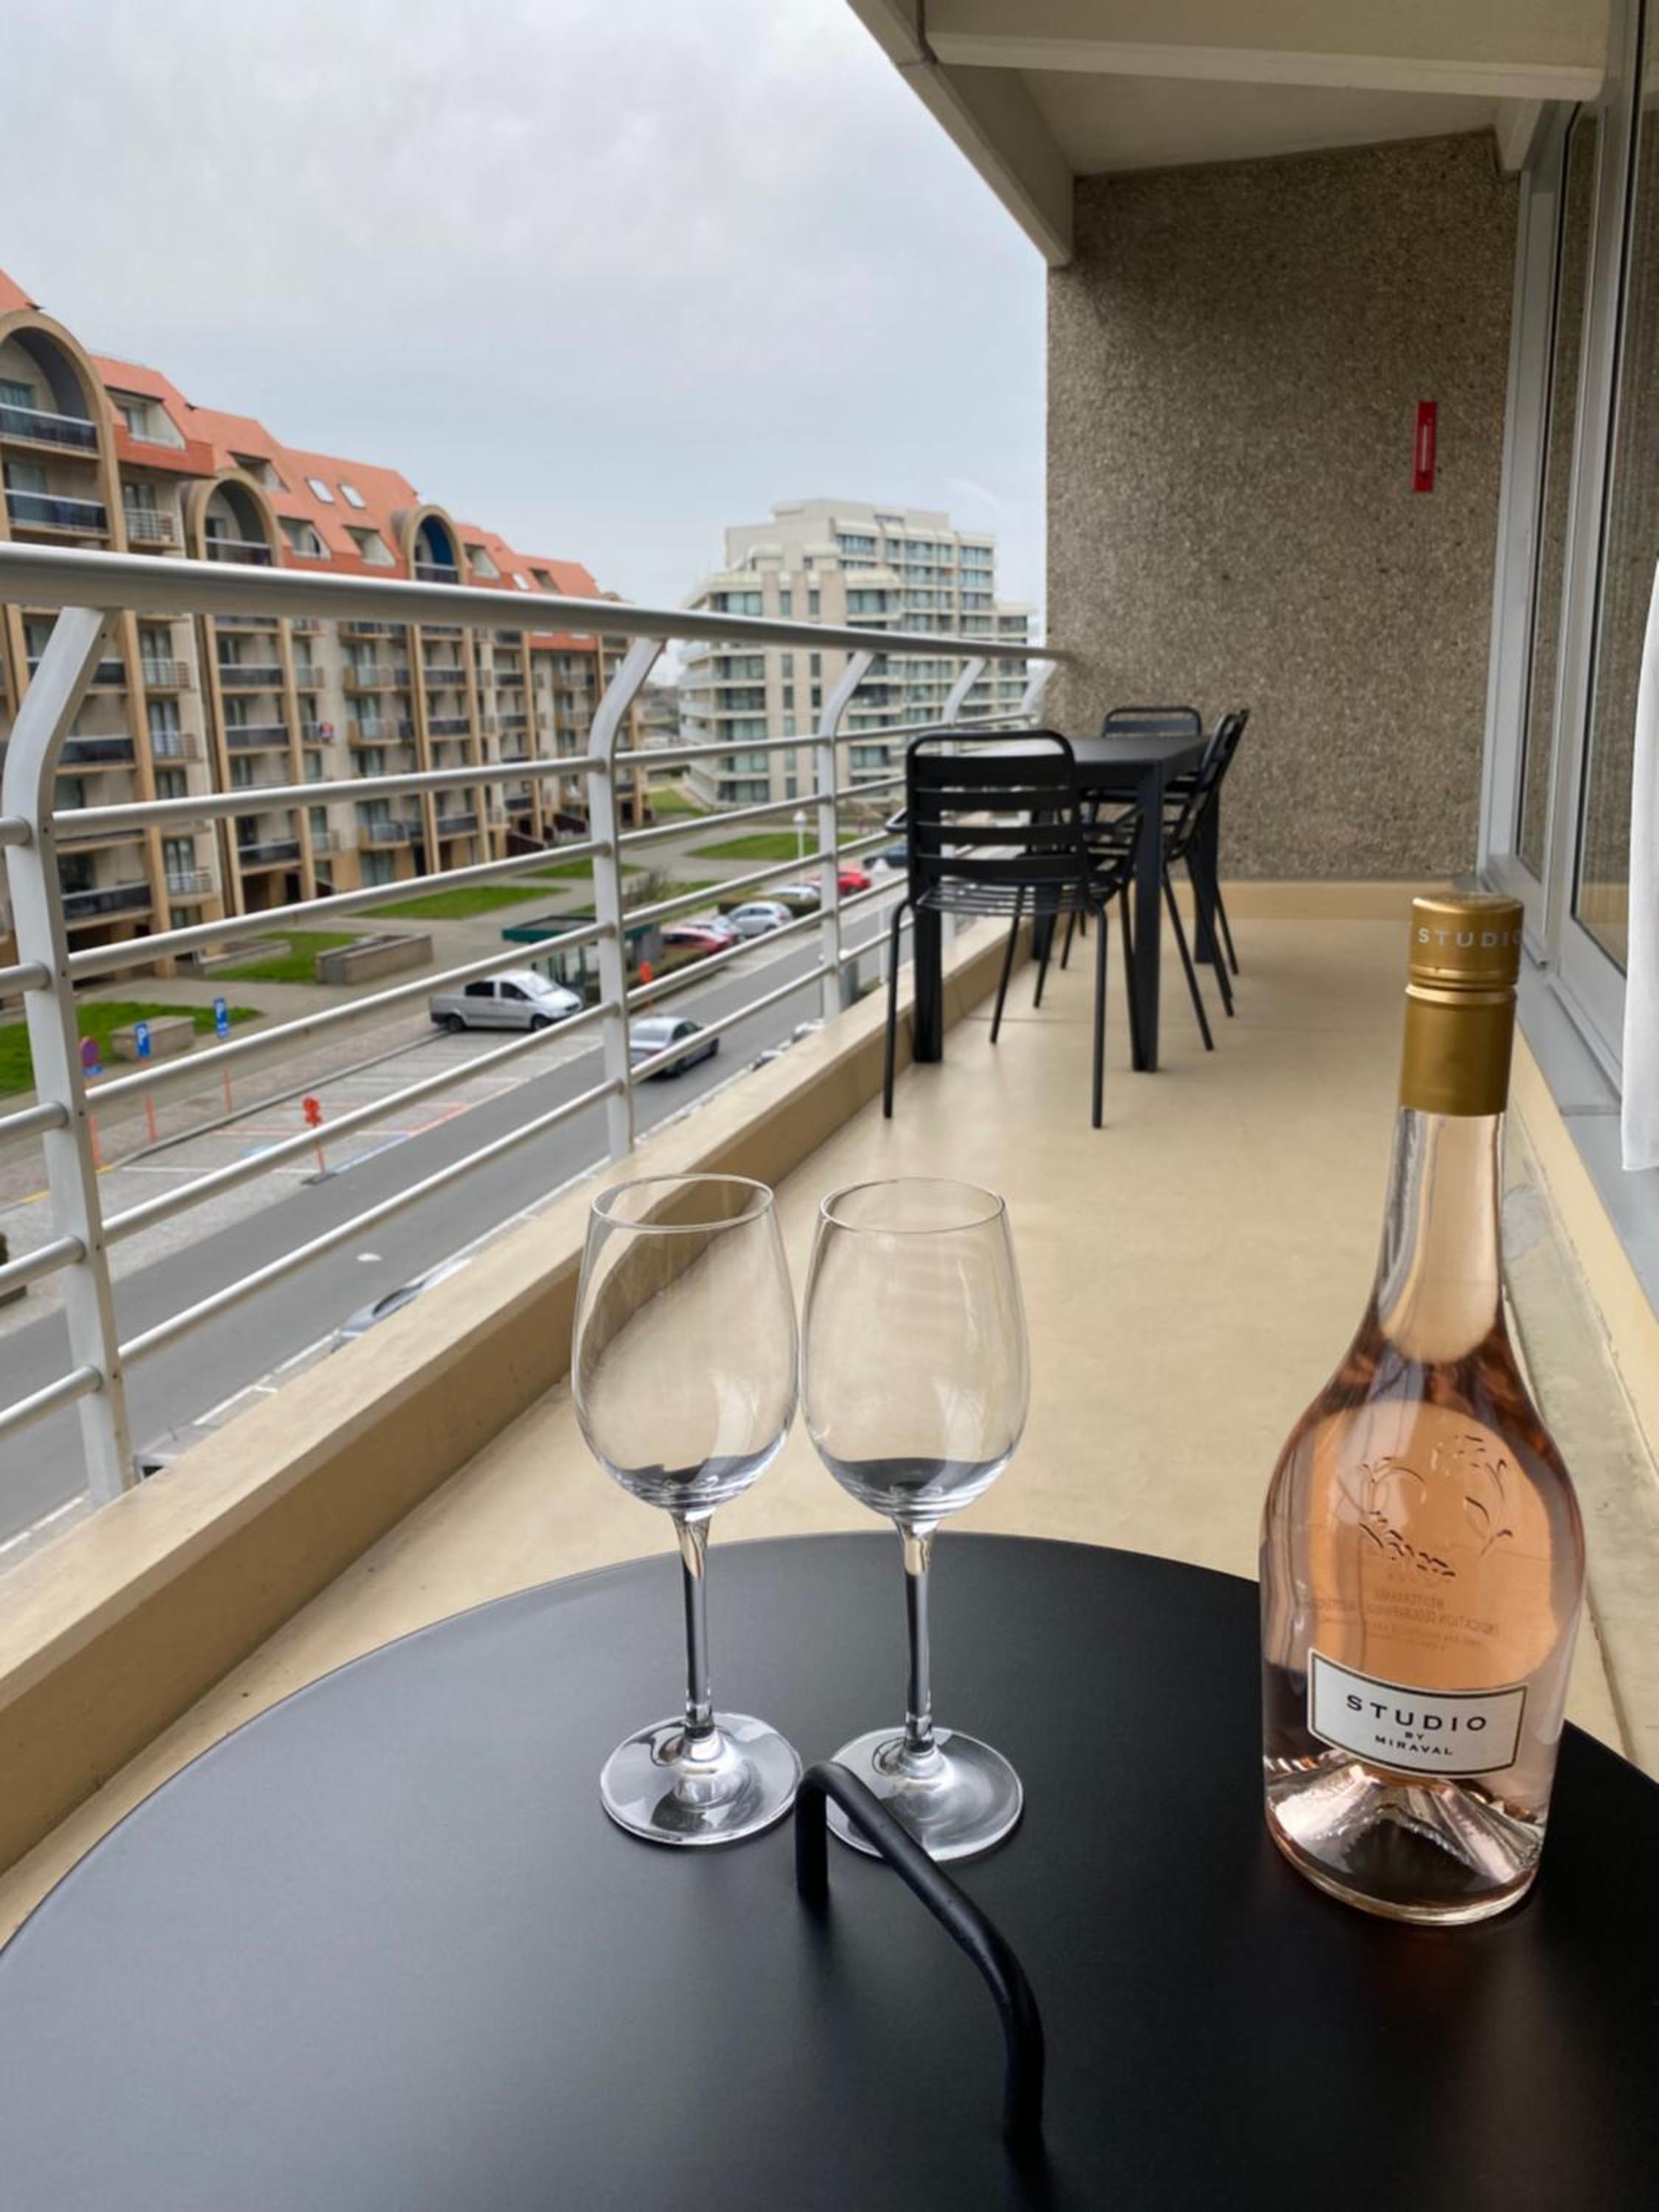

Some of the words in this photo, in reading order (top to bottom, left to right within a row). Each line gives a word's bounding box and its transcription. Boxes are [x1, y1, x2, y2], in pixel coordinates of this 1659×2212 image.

[1346, 1694, 1487, 1732] STUDIO
[1374, 1734, 1453, 1756] MIRAVAL
[1404, 1731, 1425, 1741] BY
